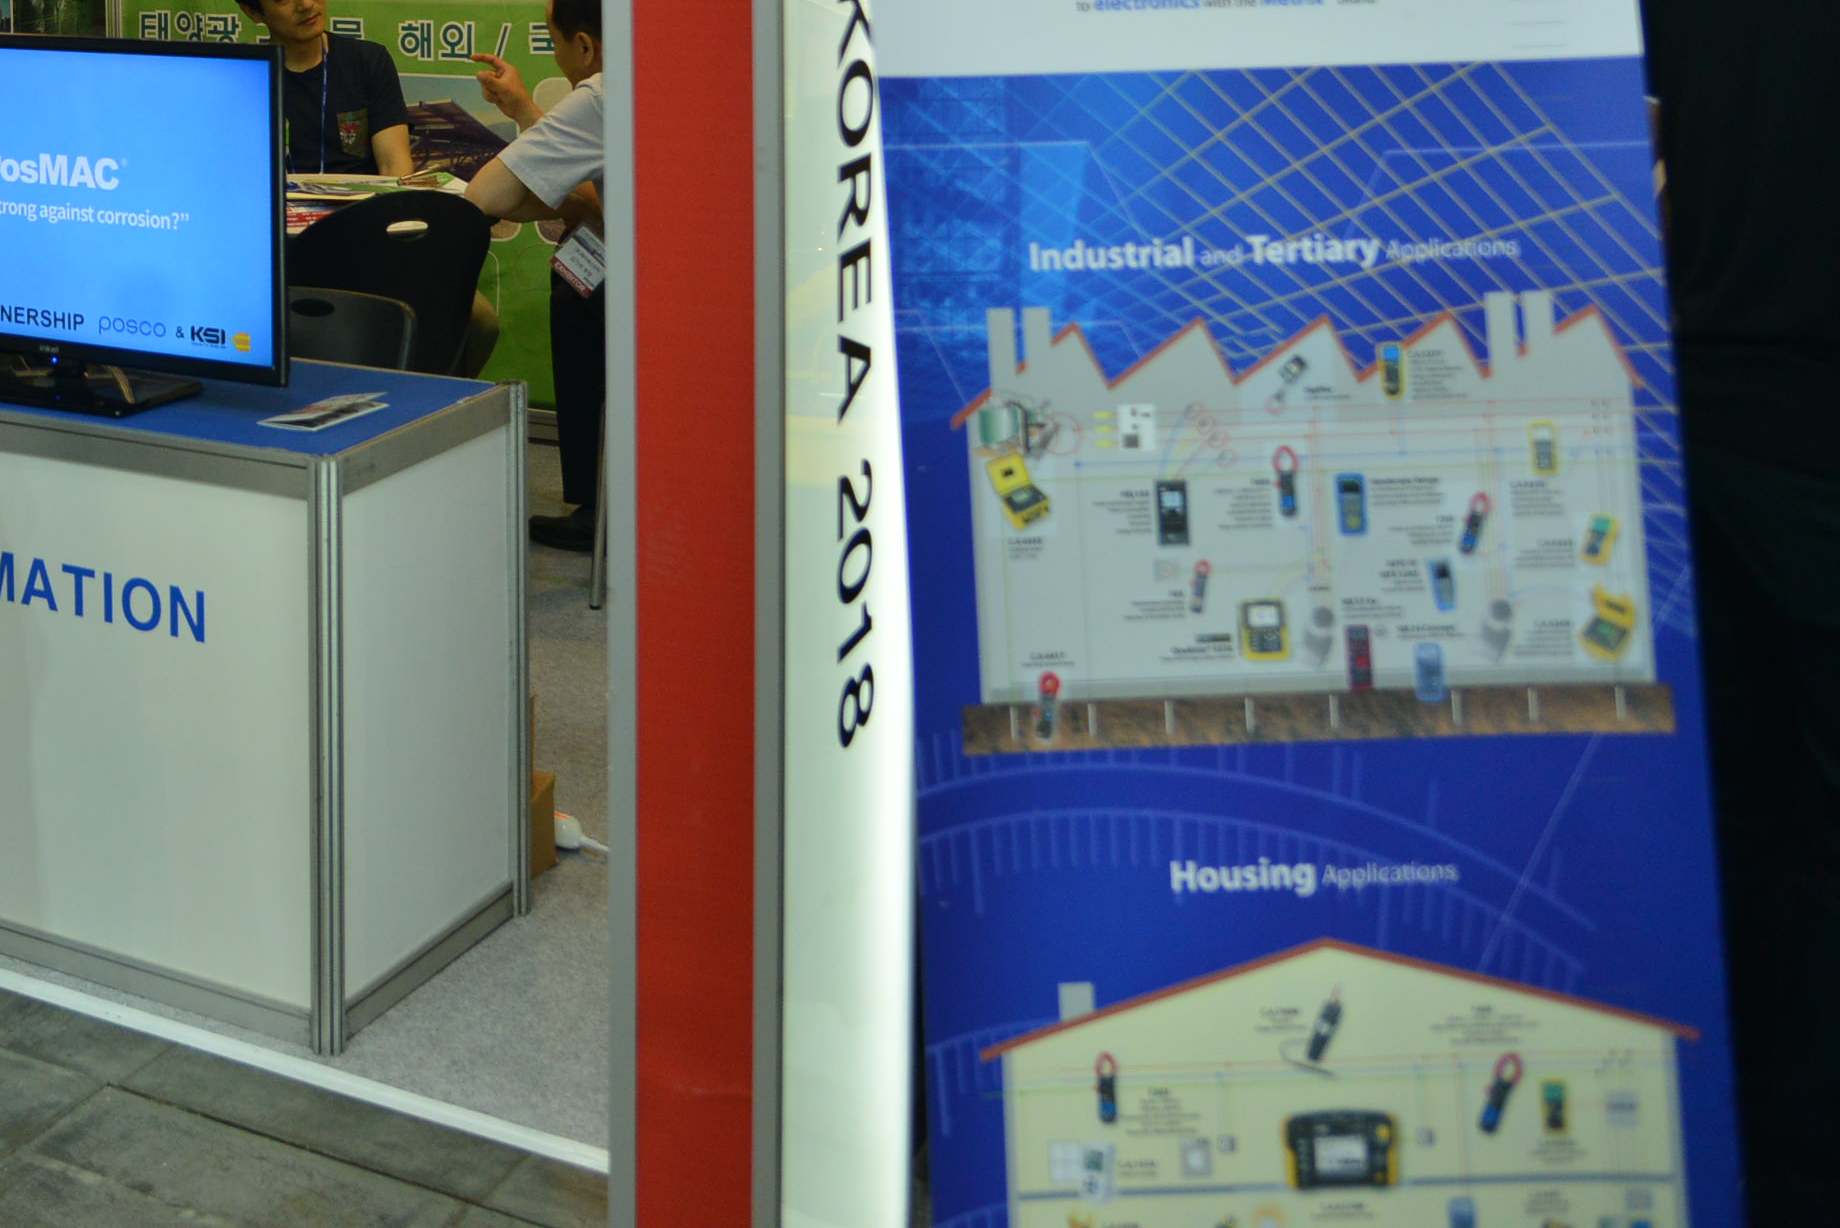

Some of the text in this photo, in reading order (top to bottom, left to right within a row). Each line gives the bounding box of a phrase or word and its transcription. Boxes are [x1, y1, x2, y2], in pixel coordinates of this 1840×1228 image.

[398, 20, 476, 62] 해외
[40, 205, 94, 225] against
[1028, 232, 1520, 273] Industrial and Tertiary Applications
[98, 315, 166, 338] posco
[175, 325, 184, 339] &
[190, 325, 226, 345] KSI
[837, 458, 874, 749] 2018
[1170, 857, 1458, 898] Housing Applications
